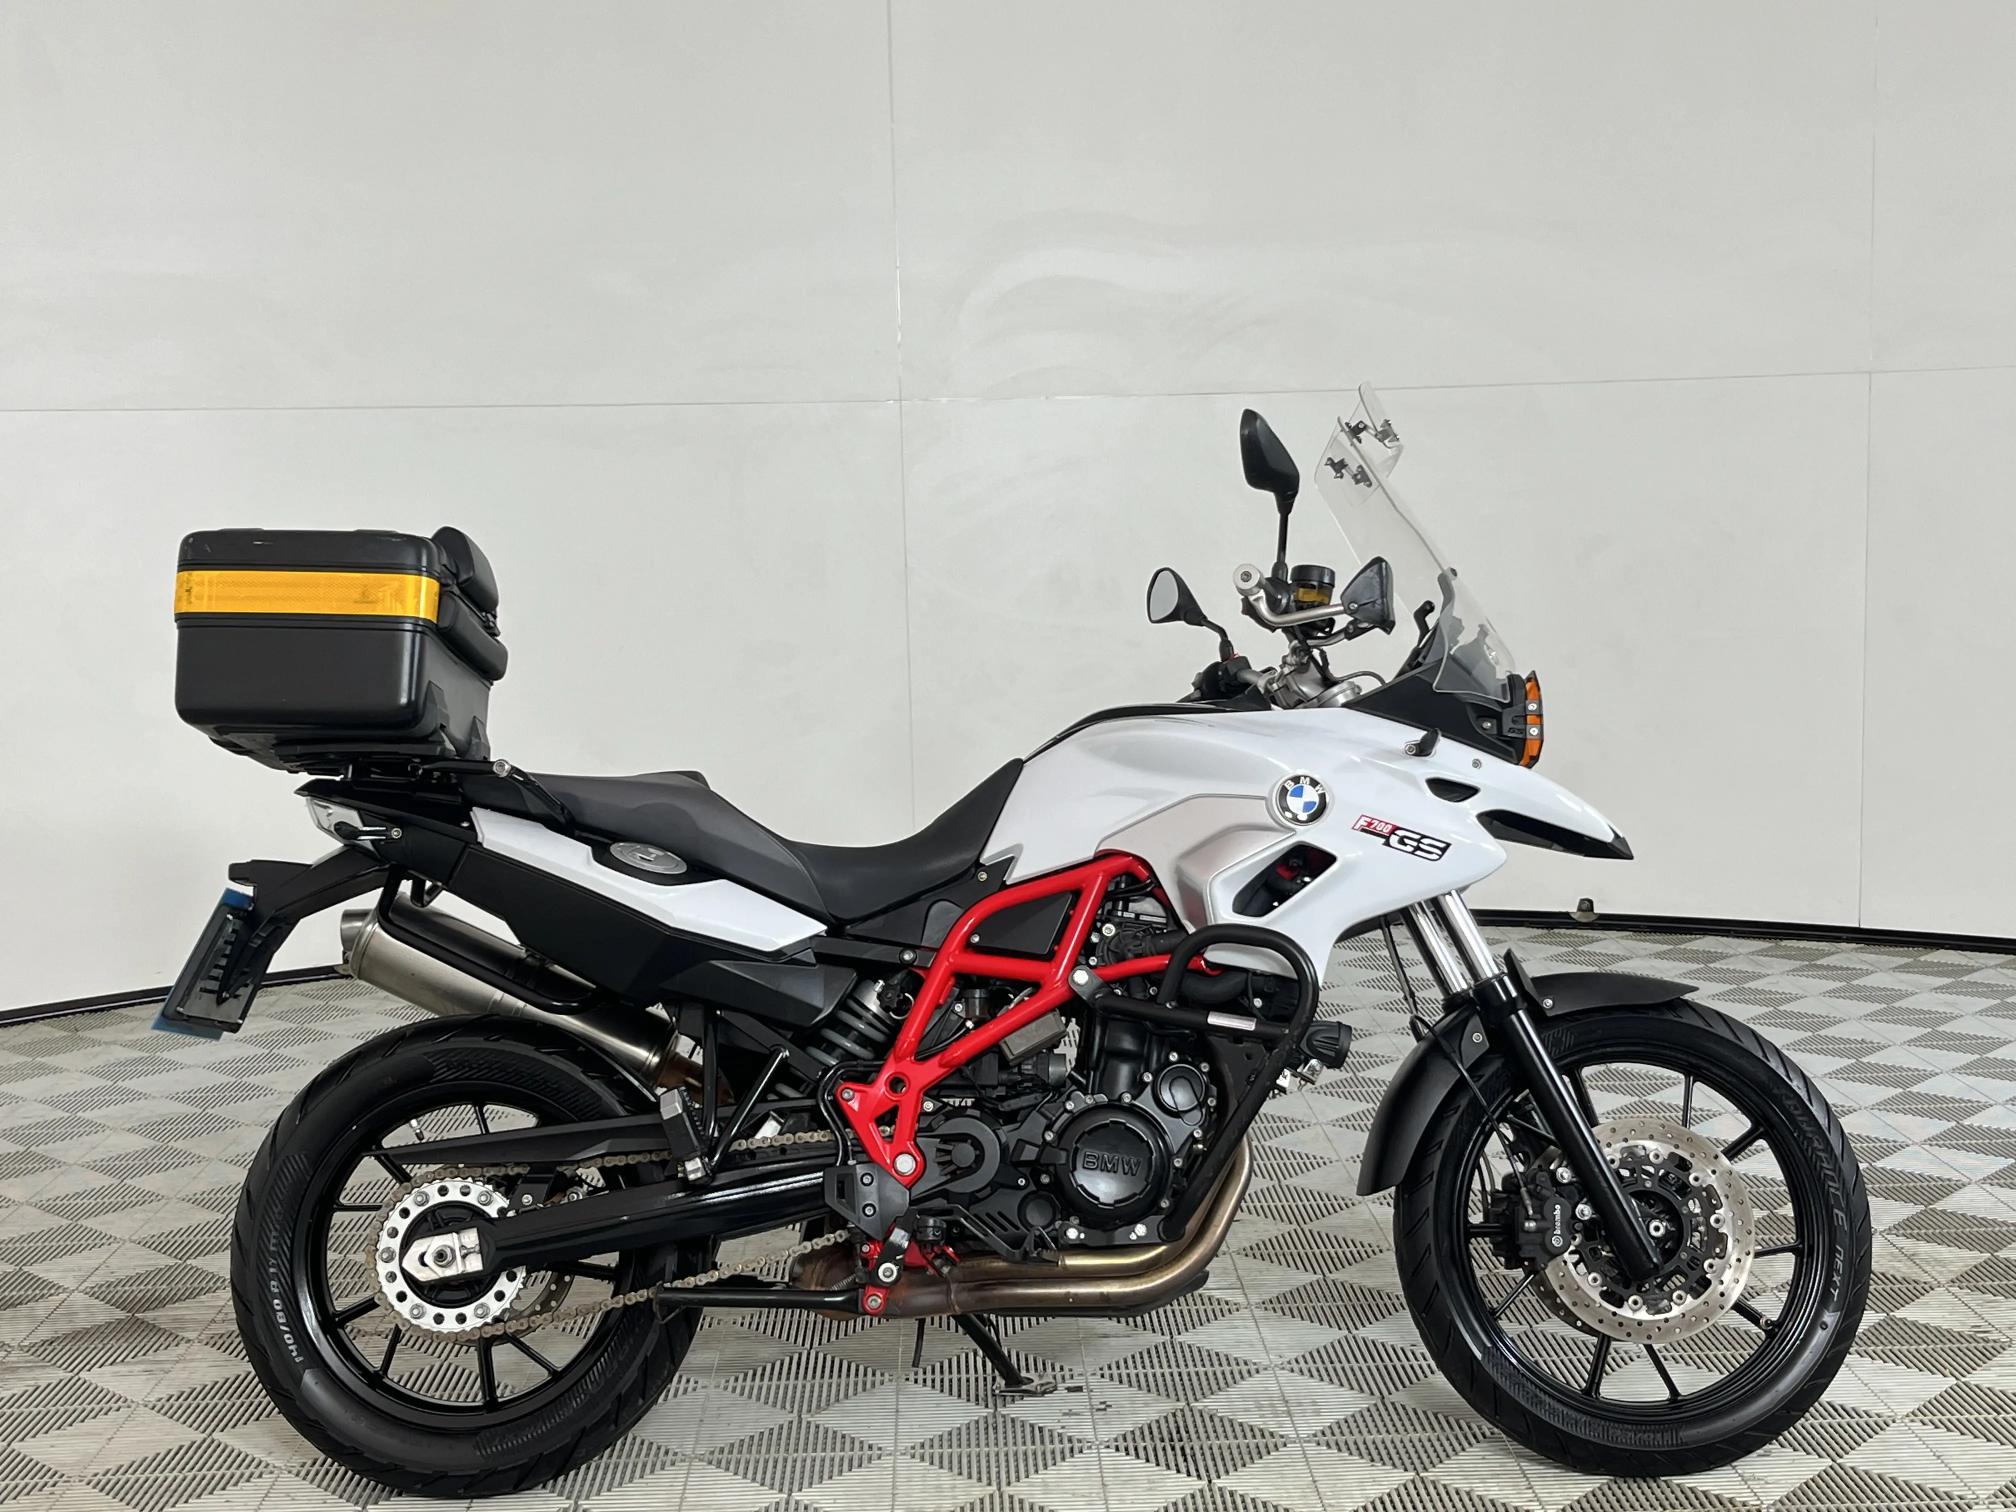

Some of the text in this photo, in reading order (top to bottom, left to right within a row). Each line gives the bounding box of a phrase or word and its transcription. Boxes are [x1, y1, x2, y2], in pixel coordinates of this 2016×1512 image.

[1283, 776, 1326, 795] BMW
[1388, 829, 1447, 861] GS
[1083, 1151, 1140, 1176] BMW
[1553, 1204, 1561, 1235] brembo
[272, 1298, 304, 1363] 140/80
